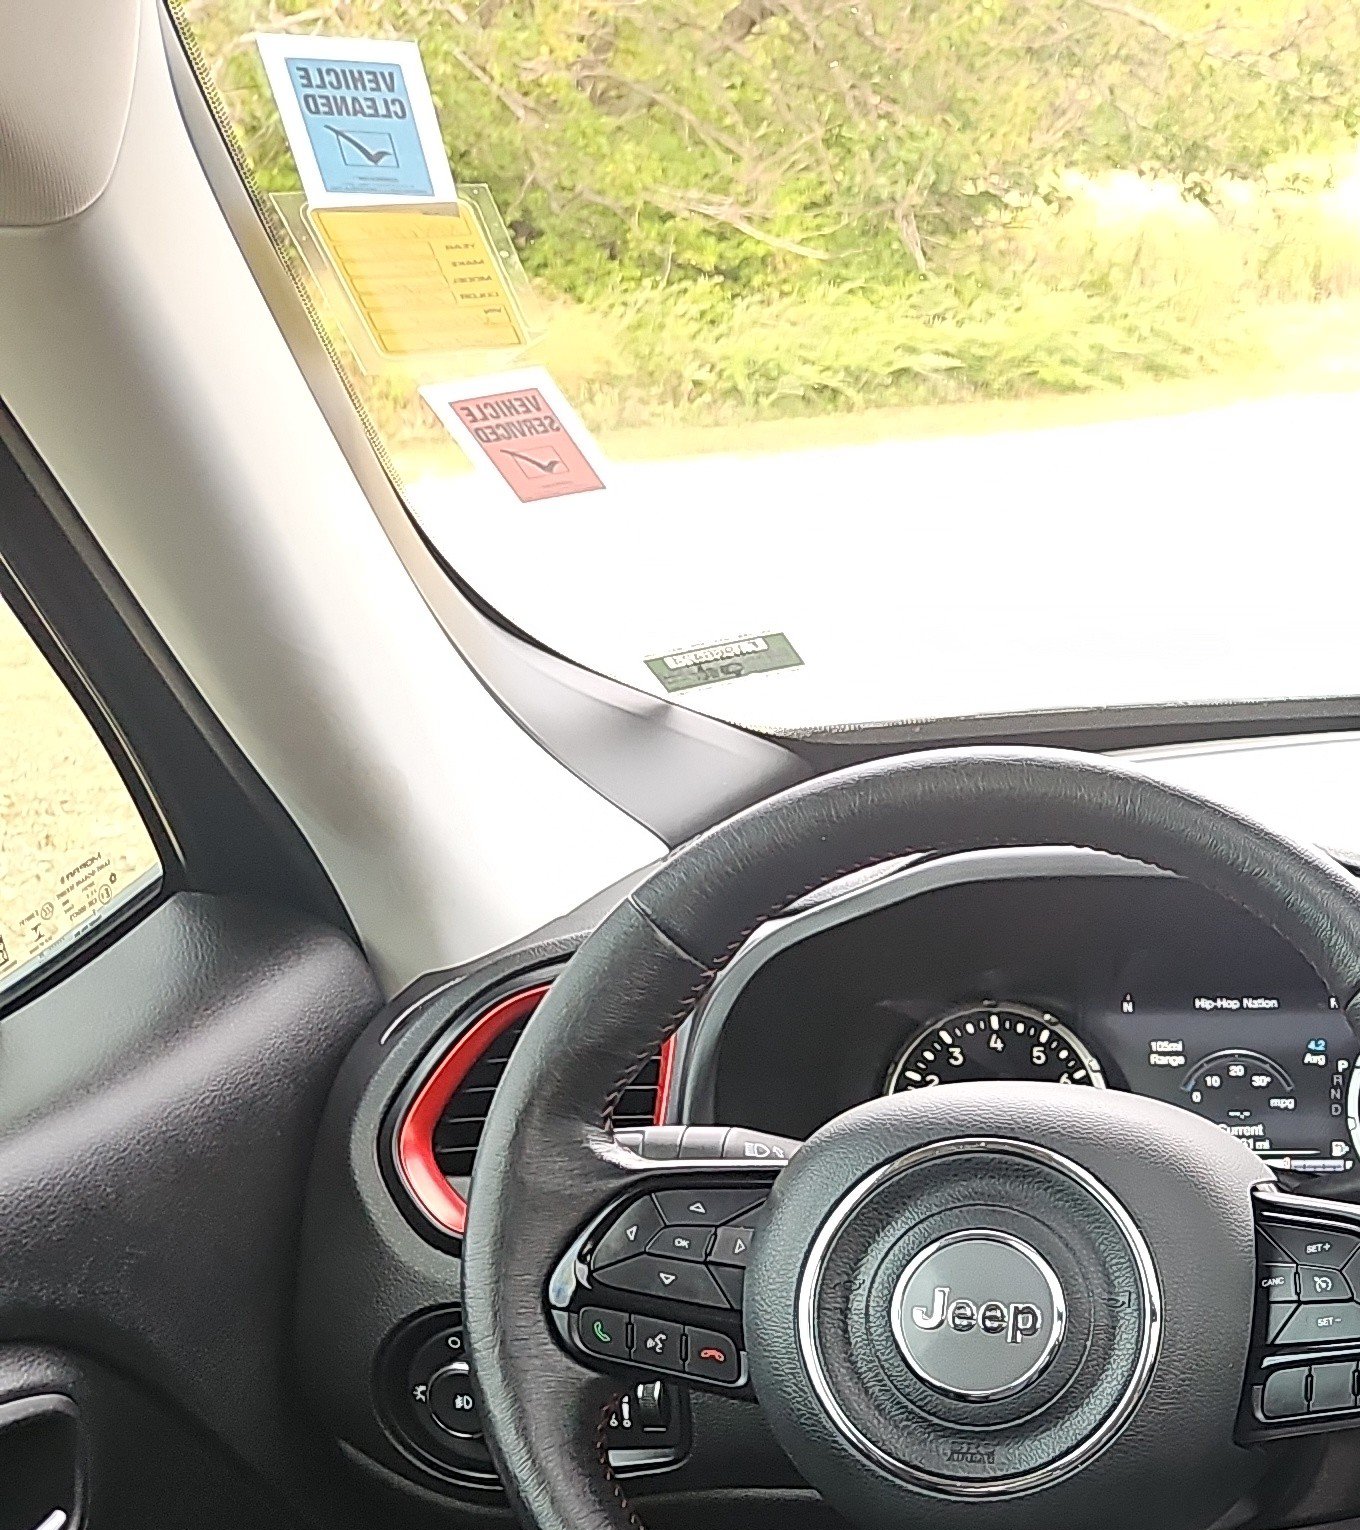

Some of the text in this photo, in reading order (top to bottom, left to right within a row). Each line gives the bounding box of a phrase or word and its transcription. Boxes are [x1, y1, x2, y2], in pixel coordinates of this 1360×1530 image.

[1243, 998, 1279, 1009] Nation
[989, 1034, 1004, 1051] 4
[949, 1048, 964, 1065] 3
[1032, 1047, 1047, 1064] 5
[1228, 1065, 1244, 1076] 20
[1337, 1060, 1348, 1072] P
[1205, 1076, 1221, 1087] 10
[1331, 1104, 1341, 1115] D
[674, 1238, 690, 1249] OK
[1261, 1276, 1285, 1288] CANC
[912, 1286, 1042, 1343] Jeep
